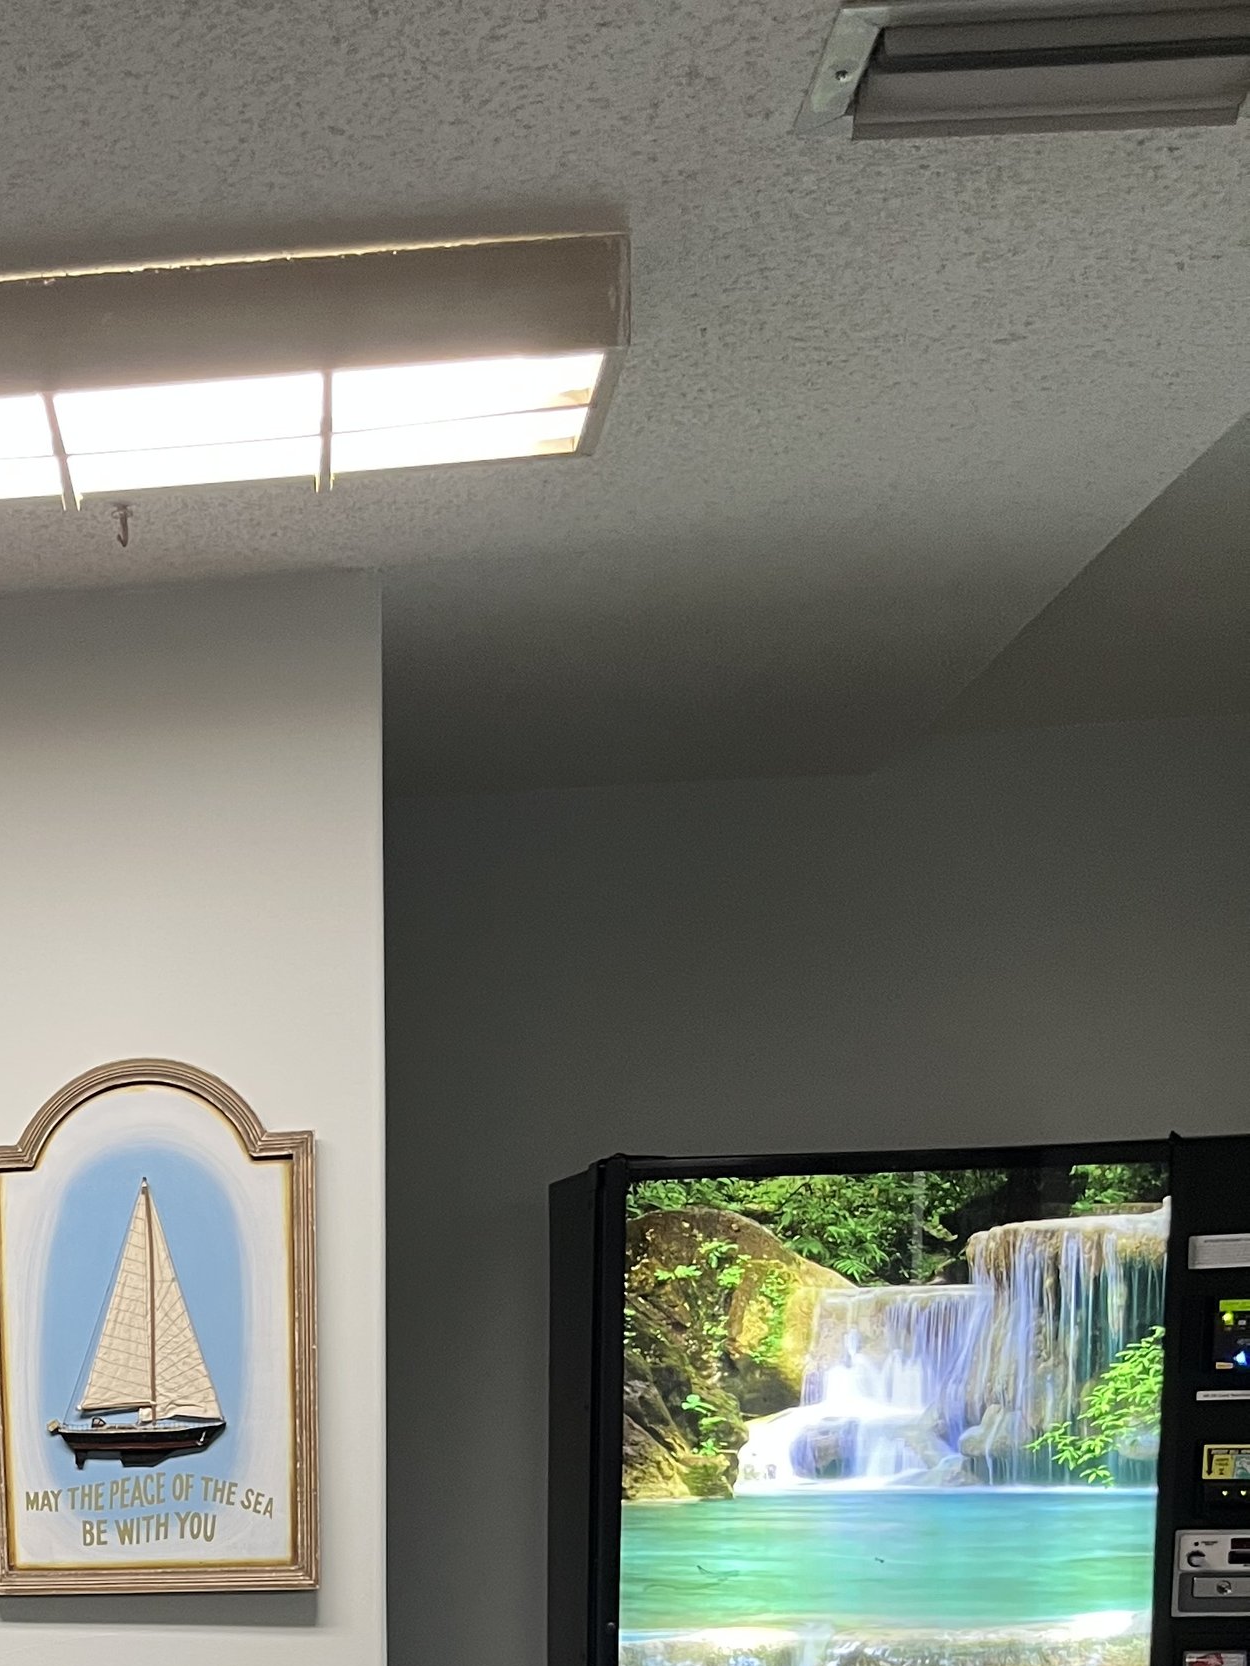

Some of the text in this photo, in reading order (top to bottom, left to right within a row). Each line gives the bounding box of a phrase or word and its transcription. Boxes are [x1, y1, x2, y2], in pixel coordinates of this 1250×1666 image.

[25, 1472, 275, 1520] MAY THE PEACE OF THE SEA
[82, 1511, 217, 1547] BE WITH YOU
